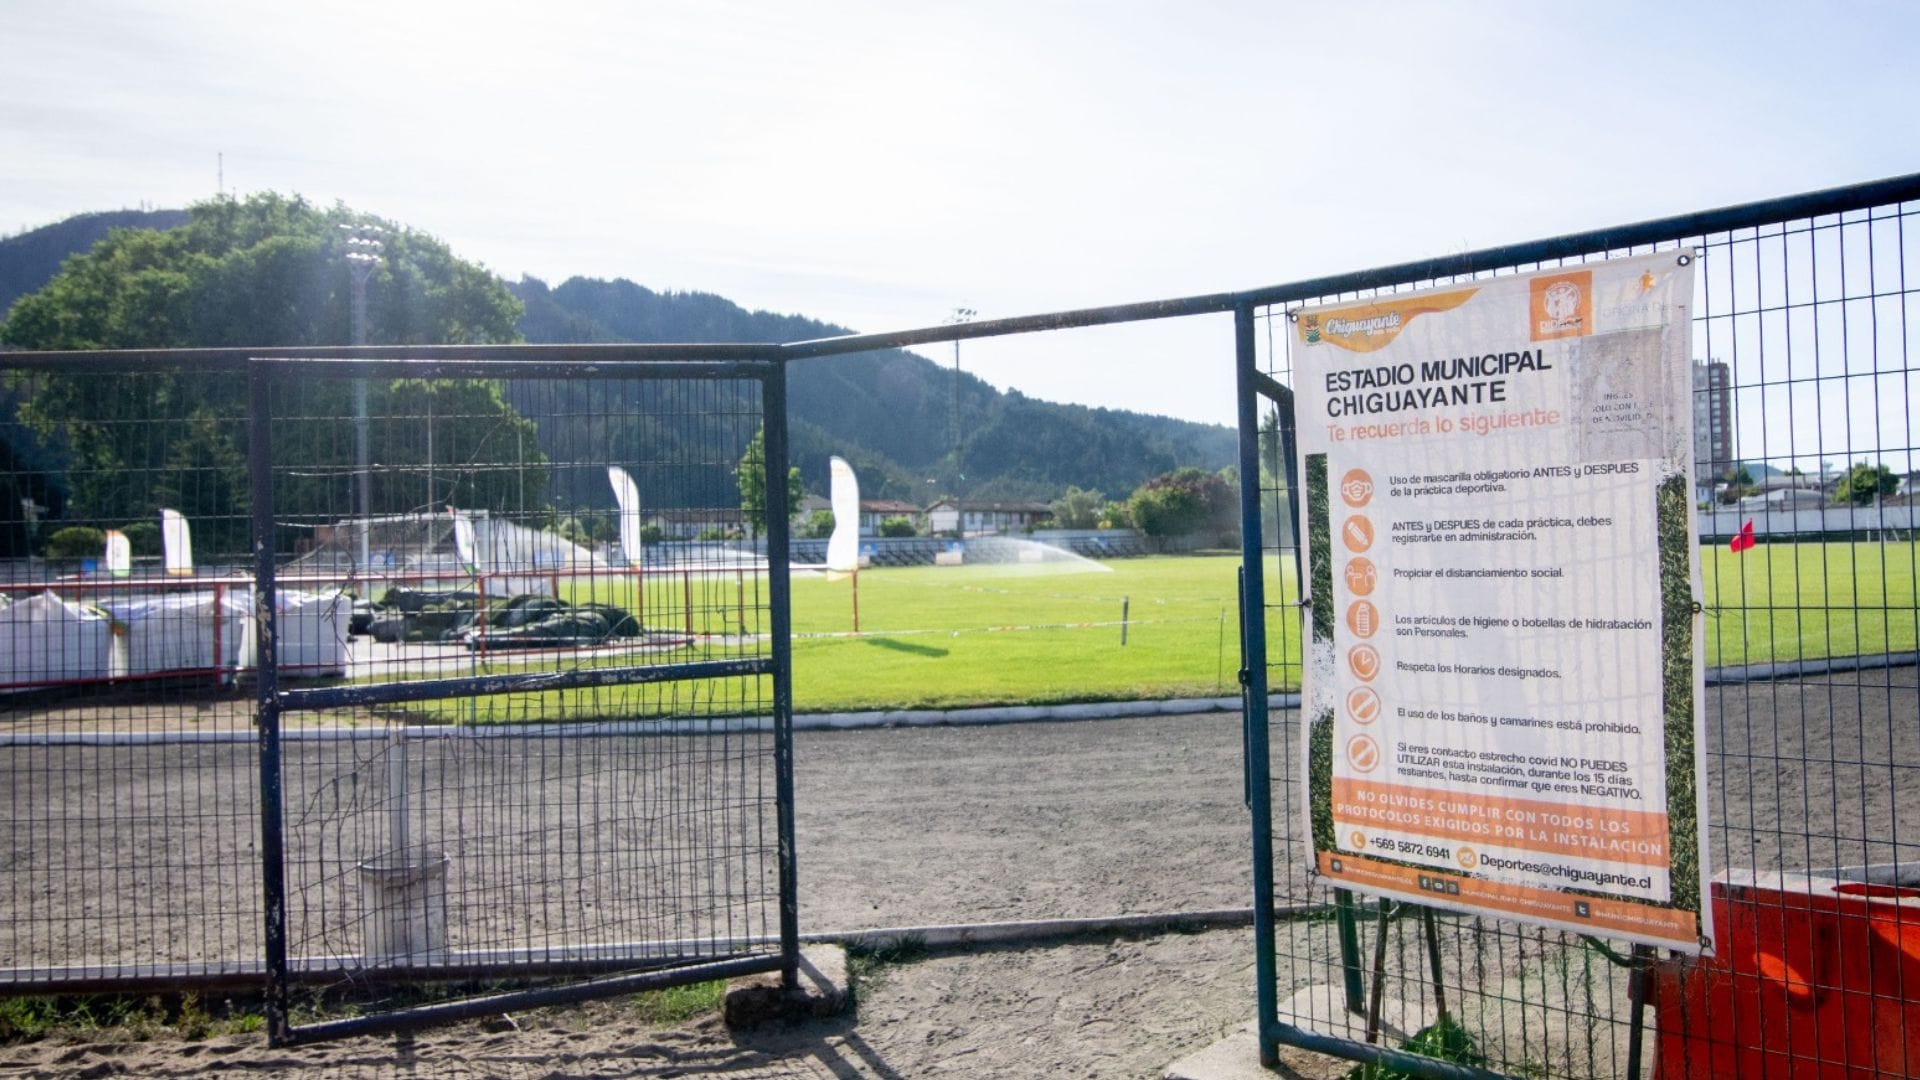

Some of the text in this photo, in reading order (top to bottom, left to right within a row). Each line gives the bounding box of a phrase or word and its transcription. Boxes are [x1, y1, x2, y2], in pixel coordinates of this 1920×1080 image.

[1326, 311, 1400, 337] Chiguayante
[1326, 349, 1552, 392] ESTADIO MUNICIPAL
[1327, 380, 1506, 417] CHIGUAYANTE
[1327, 407, 1560, 442] Te recuerda lo siguiente
[1390, 463, 1639, 485] Uso de mascarilla obligatorio ANTES y DESPUES
[1391, 488, 1401, 496] de
[1404, 487, 1411, 496] la
[1455, 482, 1506, 496] deportiva.
[1392, 521, 1424, 531] ANTES
[1426, 523, 1432, 533] y
[1434, 519, 1480, 530] DESPUES
[1483, 519, 1495, 528] de
[1498, 518, 1524, 528] cada
[1577, 516, 1612, 526] debes
[1392, 534, 1442, 545] registrarte
[1459, 530, 1537, 542] administración.
[1394, 567, 1564, 580] Propiciar el distanciamiento social.
[1395, 614, 1411, 624] Los
[1458, 616, 1471, 625] de
[1473, 616, 1509, 629] higiene
[1512, 619, 1519, 627] o
[1522, 618, 1566, 628] botellas
[1568, 618, 1582, 628] de
[1585, 618, 1652, 629] hidratación
[1396, 627, 1468, 638] son Personales.
[1396, 661, 1562, 679] Respeta los Horarios designados.
[1397, 707, 1641, 734] El uso de los baños y camarines está prohibido.
[1397, 742, 1628, 772] Si eres contacto estrecho covid NO PUEDES
[1397, 754, 1632, 785] UTILIZAR esta instalación, durante los 15 días
[1397, 767, 1642, 799] restantes, hasta confirmar que eres NEGATIVO.
[1357, 790, 1630, 833] NO OLVIDES CUMPLIR CON TODOS LOS
[1337, 803, 1662, 856] PROTOCOLOS EXIGIDOS POR LA INSTALACIÓN
[1370, 837, 1450, 860] +569 5872 6941
[1480, 853, 1651, 888] Deportes@chiguayante.cl
